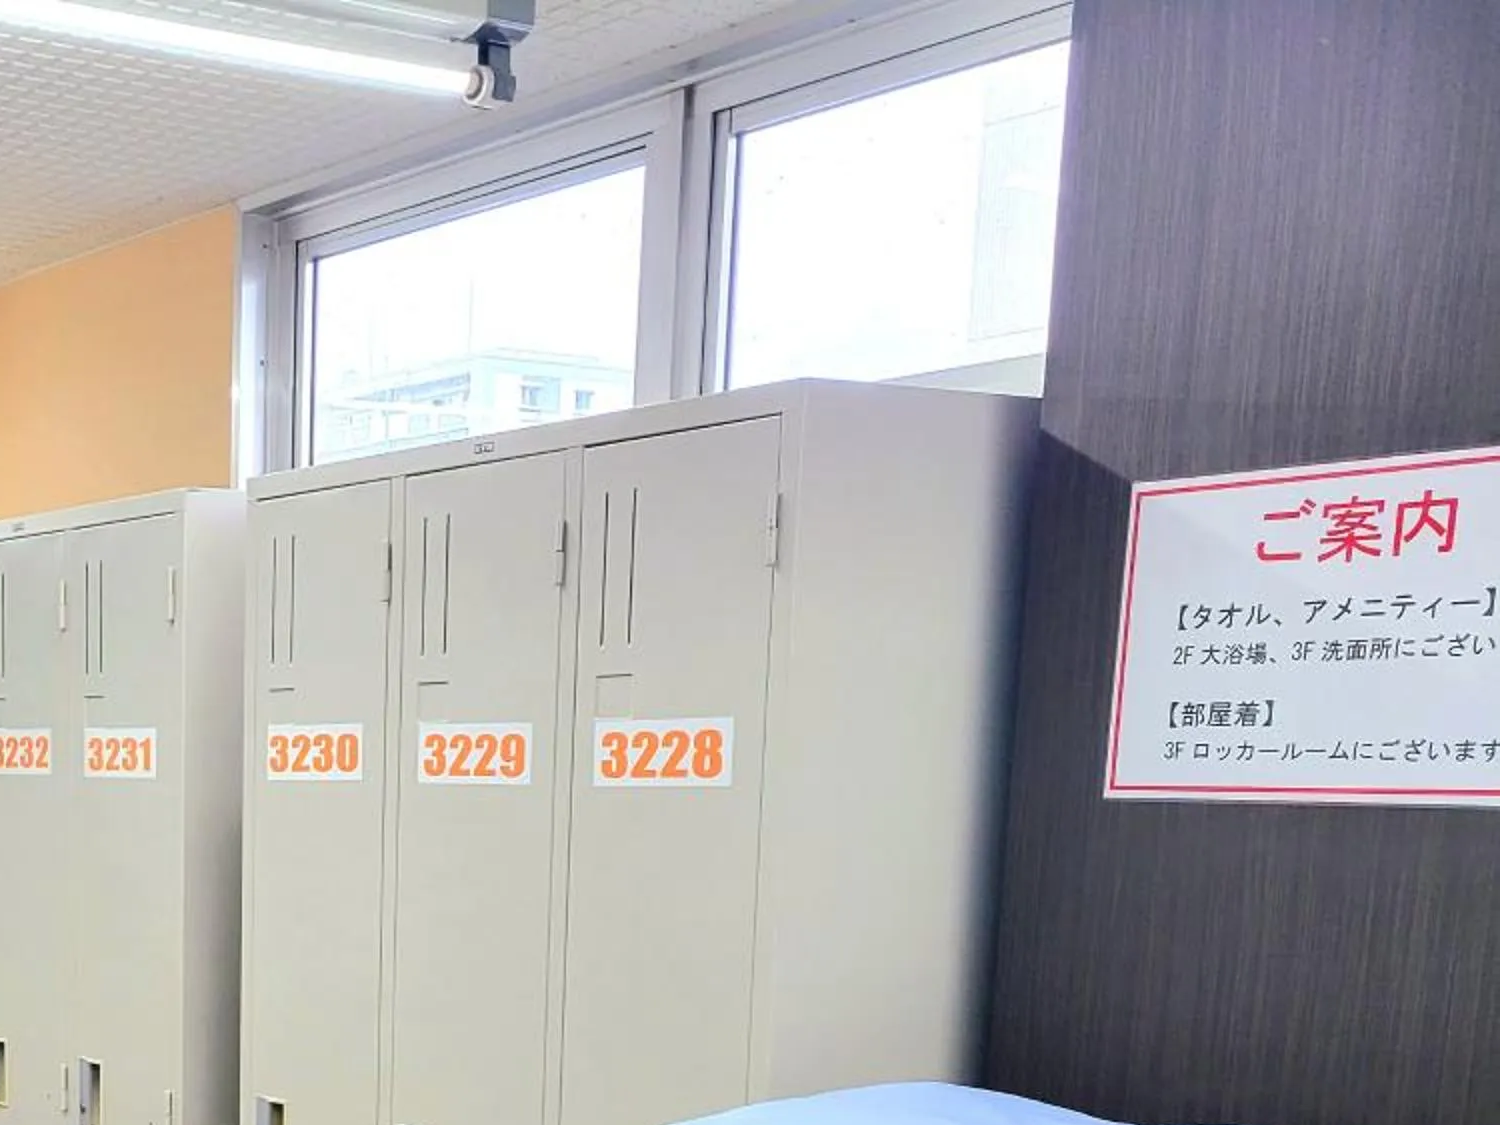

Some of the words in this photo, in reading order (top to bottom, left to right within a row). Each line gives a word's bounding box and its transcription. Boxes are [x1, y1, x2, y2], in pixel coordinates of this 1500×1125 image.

[1256, 490, 1459, 563] ご案内
[1178, 587, 1498, 631] 【タオル、アメニティー】
[1165, 699, 1276, 729] 【部屋着】
[88, 736, 152, 771] 3231
[269, 733, 359, 773] 3230
[423, 733, 526, 778] 3229
[601, 729, 723, 779] 3228
